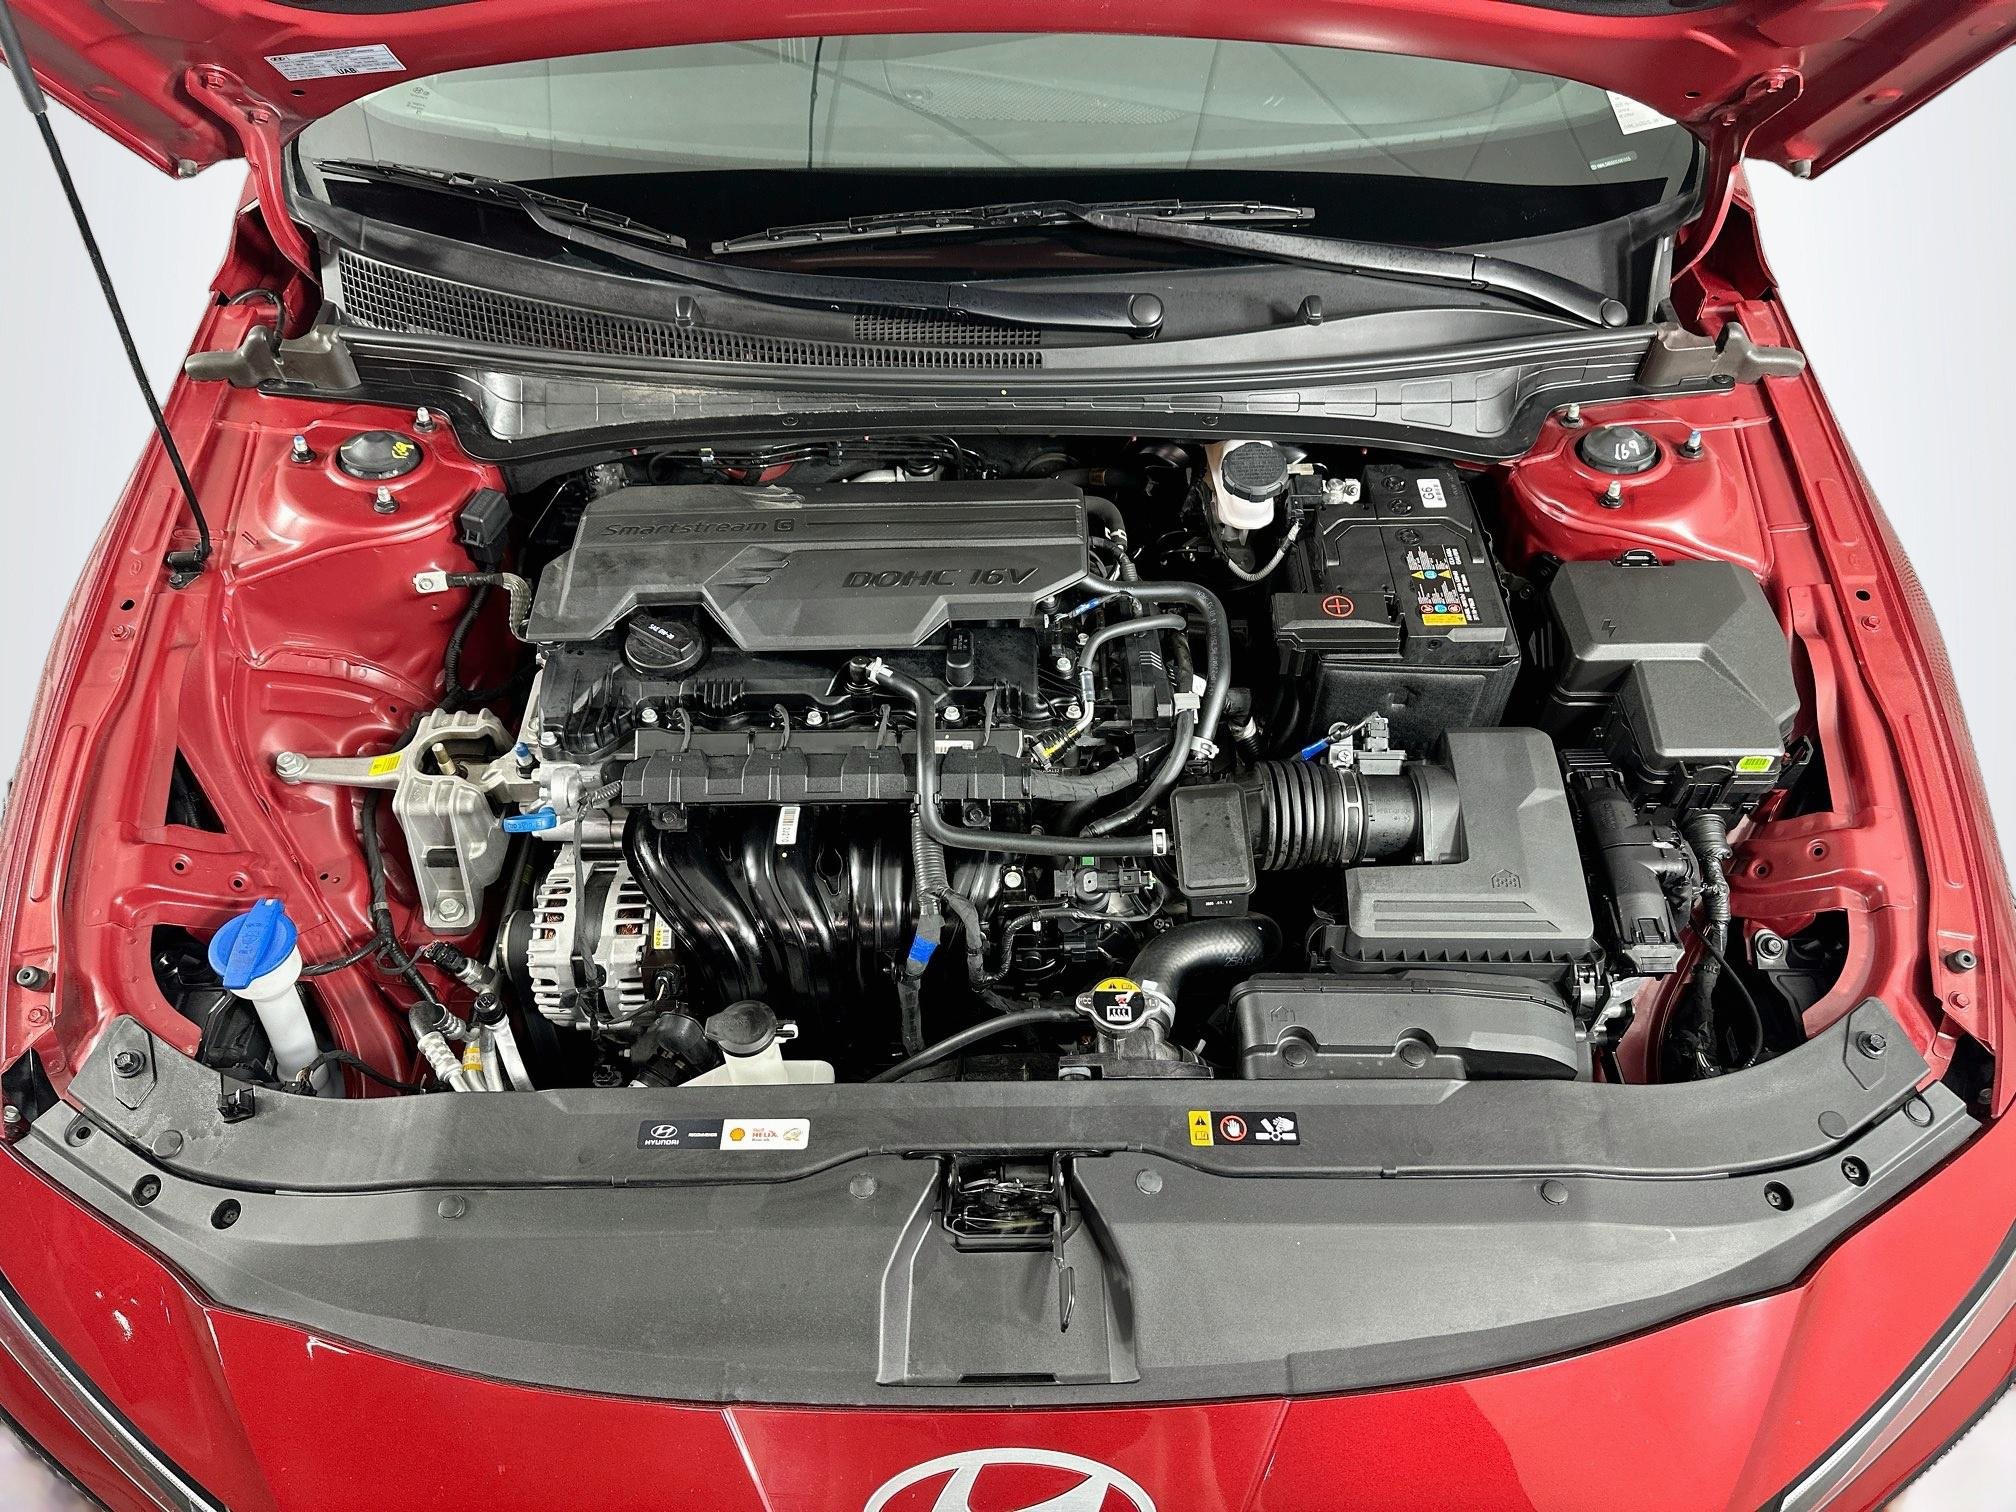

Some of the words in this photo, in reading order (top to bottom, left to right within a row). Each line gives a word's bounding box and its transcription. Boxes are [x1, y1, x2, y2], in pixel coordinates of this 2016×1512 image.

[1614, 439, 1641, 460] 169
[1421, 486, 1435, 500] G6
[601, 520, 768, 536] Smartstream
[843, 569, 962, 588] DOHC
[968, 567, 1039, 587] 16V
